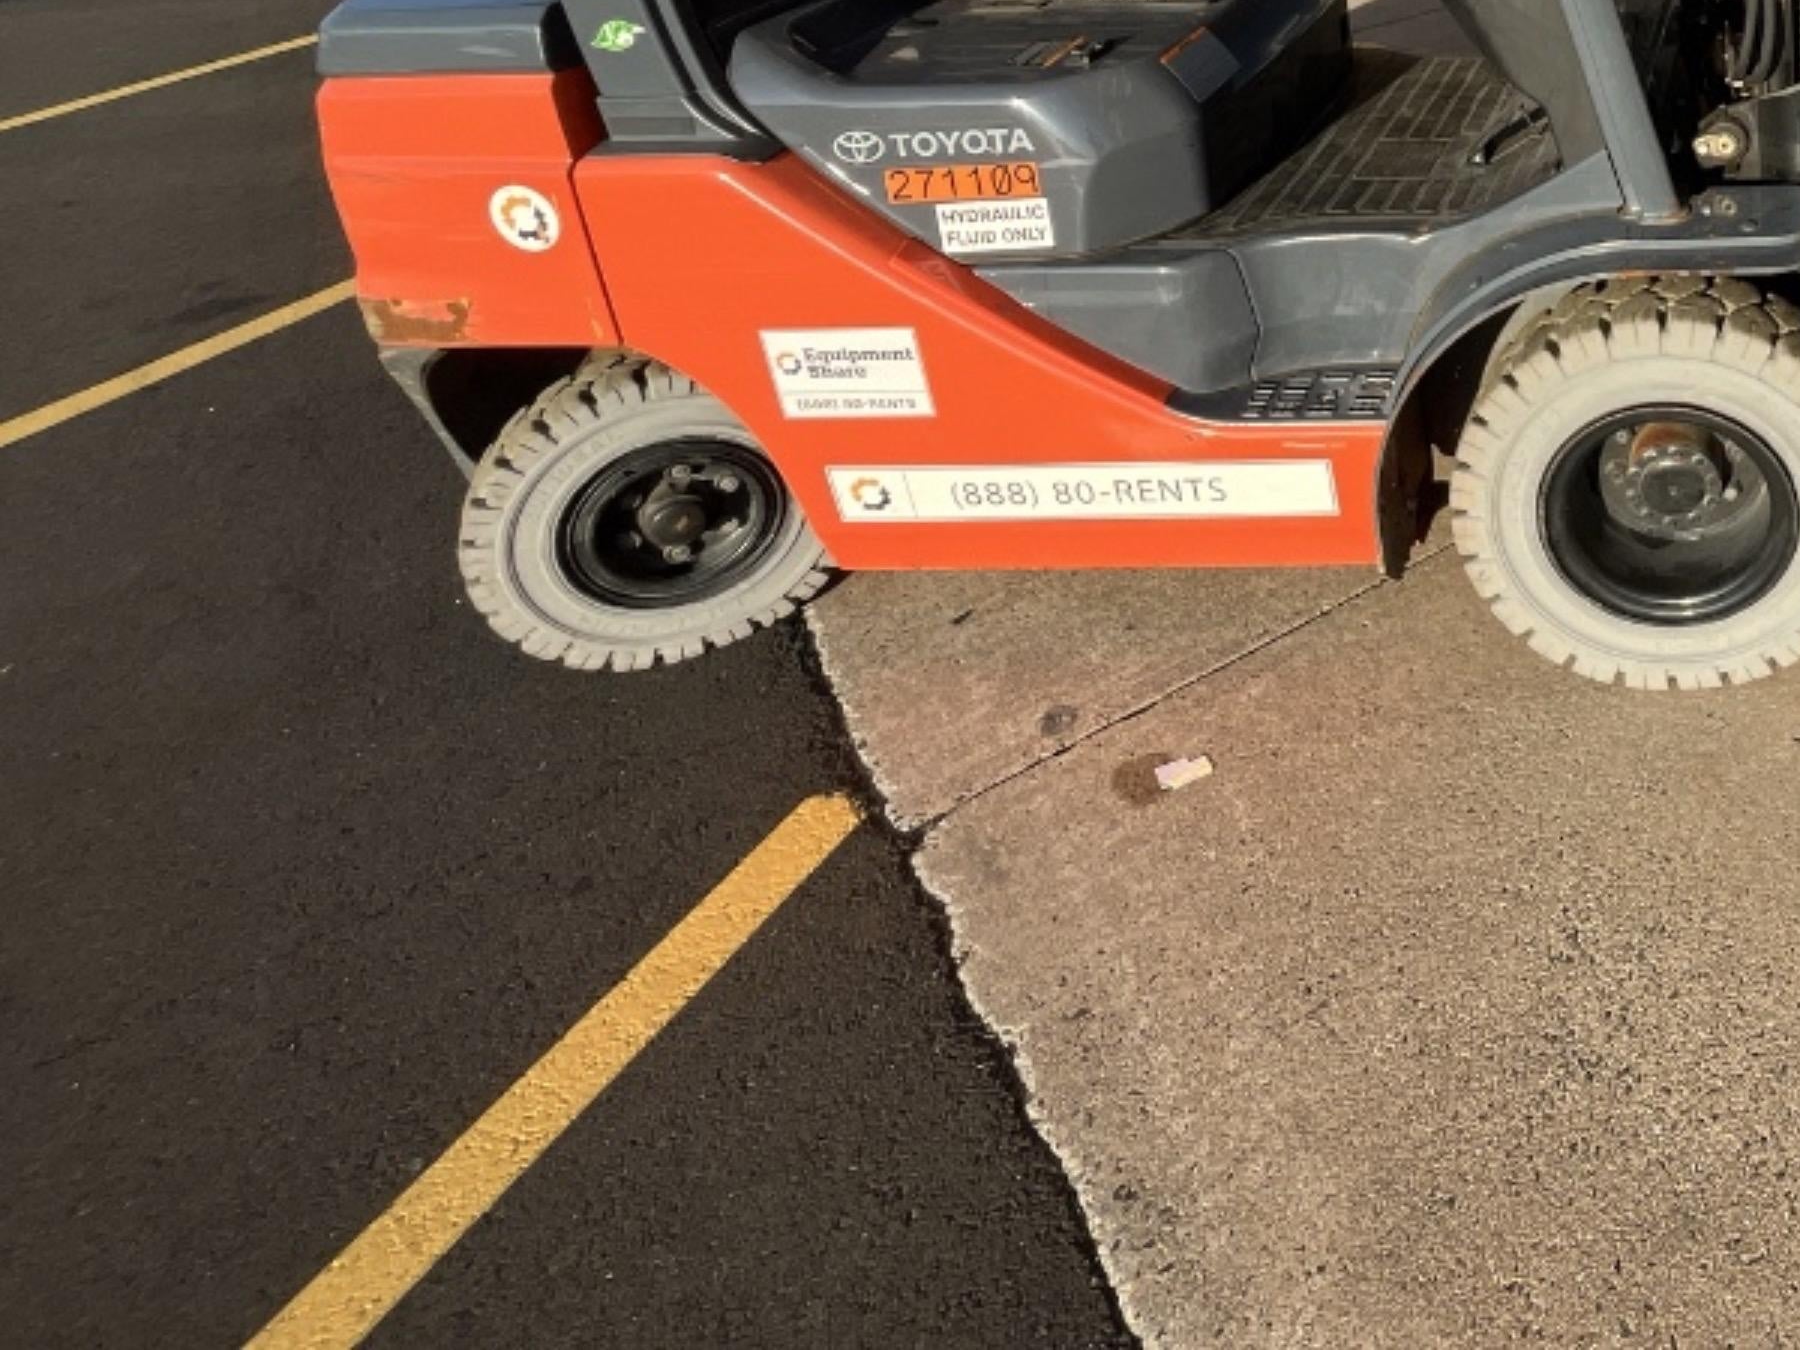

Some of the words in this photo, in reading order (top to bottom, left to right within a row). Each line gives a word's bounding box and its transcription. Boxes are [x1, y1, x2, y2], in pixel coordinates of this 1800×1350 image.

[888, 128, 1036, 158] TOYOTA
[889, 163, 1040, 200] 271109
[941, 203, 1045, 225] HYDRAULIC
[947, 227, 998, 245] FLUID
[1002, 225, 1047, 244] ONLY
[802, 347, 914, 364] Equipment
[950, 480, 1040, 510] (888)
[1052, 477, 1229, 506] 80-RENTS
